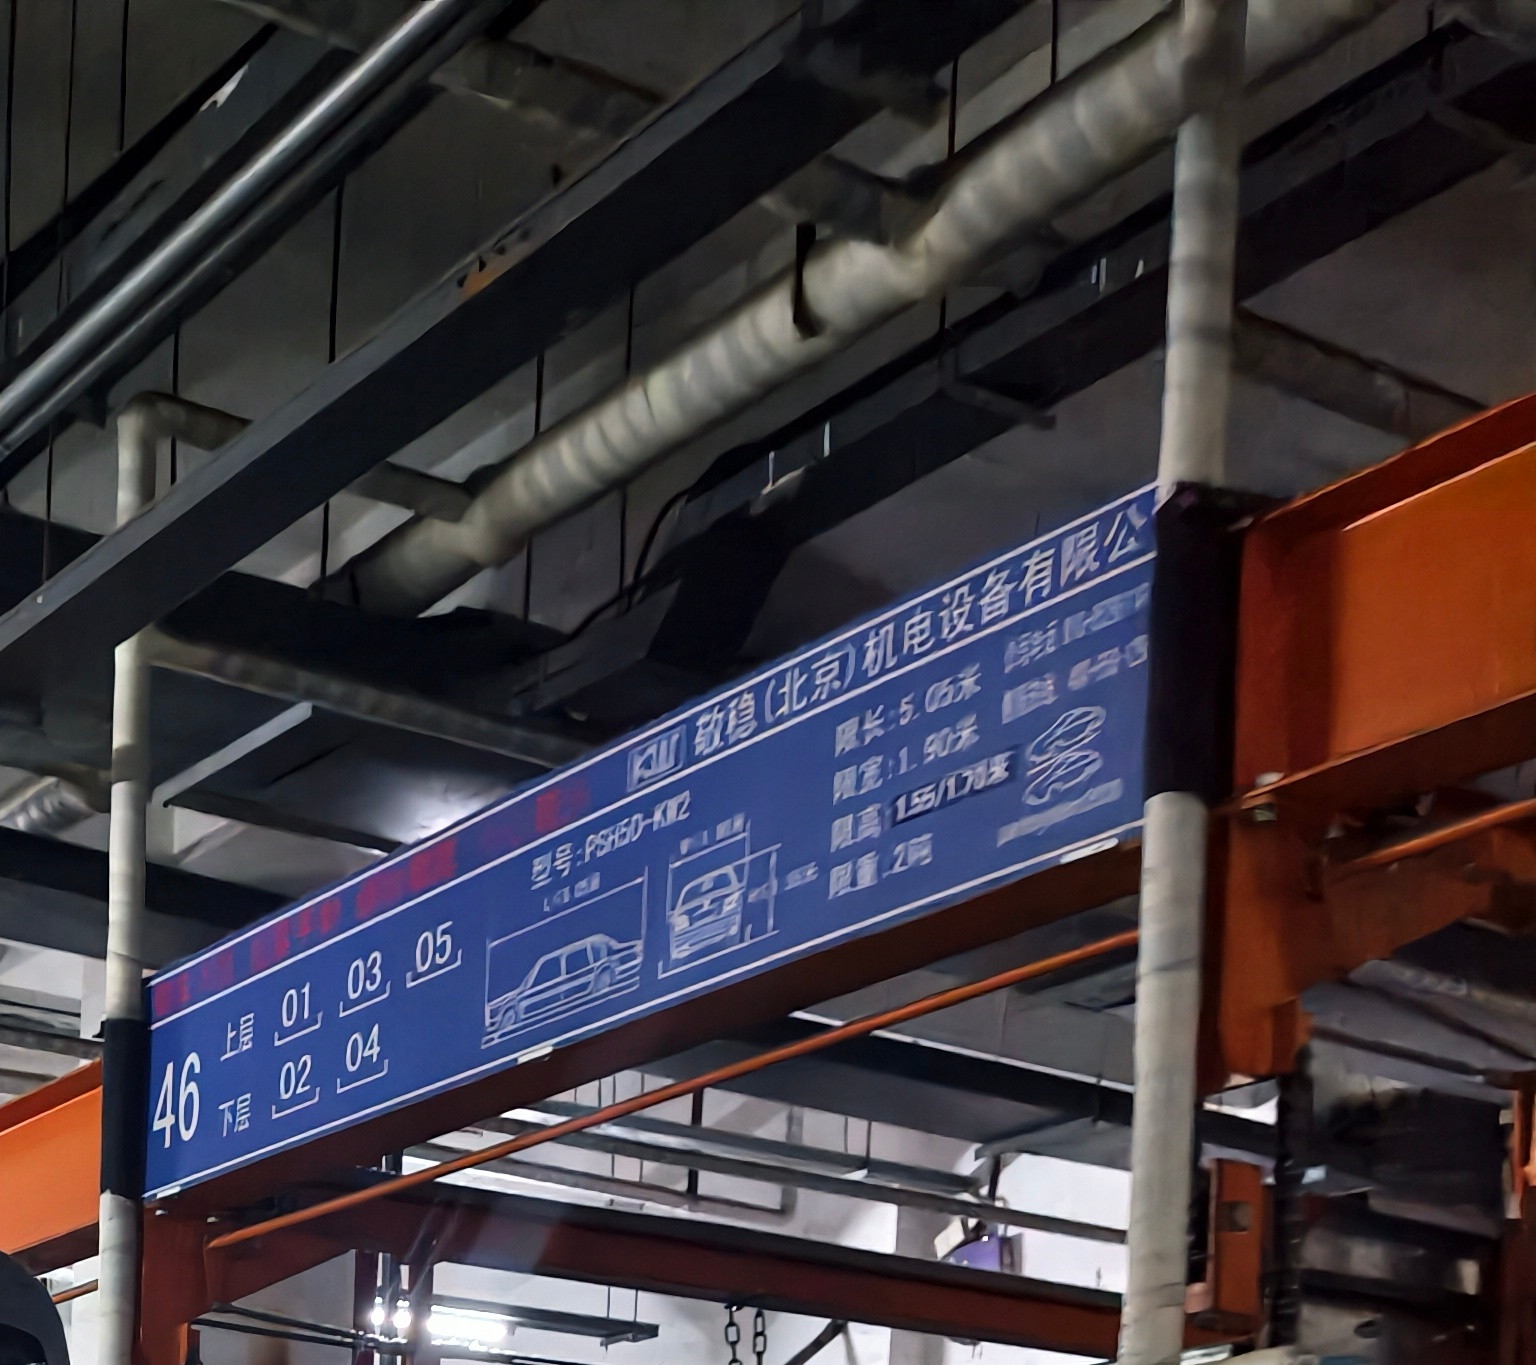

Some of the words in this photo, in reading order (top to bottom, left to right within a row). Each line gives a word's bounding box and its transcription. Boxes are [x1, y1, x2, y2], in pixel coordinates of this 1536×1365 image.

[281, 981, 311, 1028] 01
[347, 950, 382, 1000] 03
[415, 920, 453, 973] 05
[220, 1012, 254, 1062] 上层
[279, 1054, 312, 1100] 02
[345, 1022, 381, 1073] 04
[152, 1051, 201, 1149] 46
[218, 1092, 252, 1138] 下层
